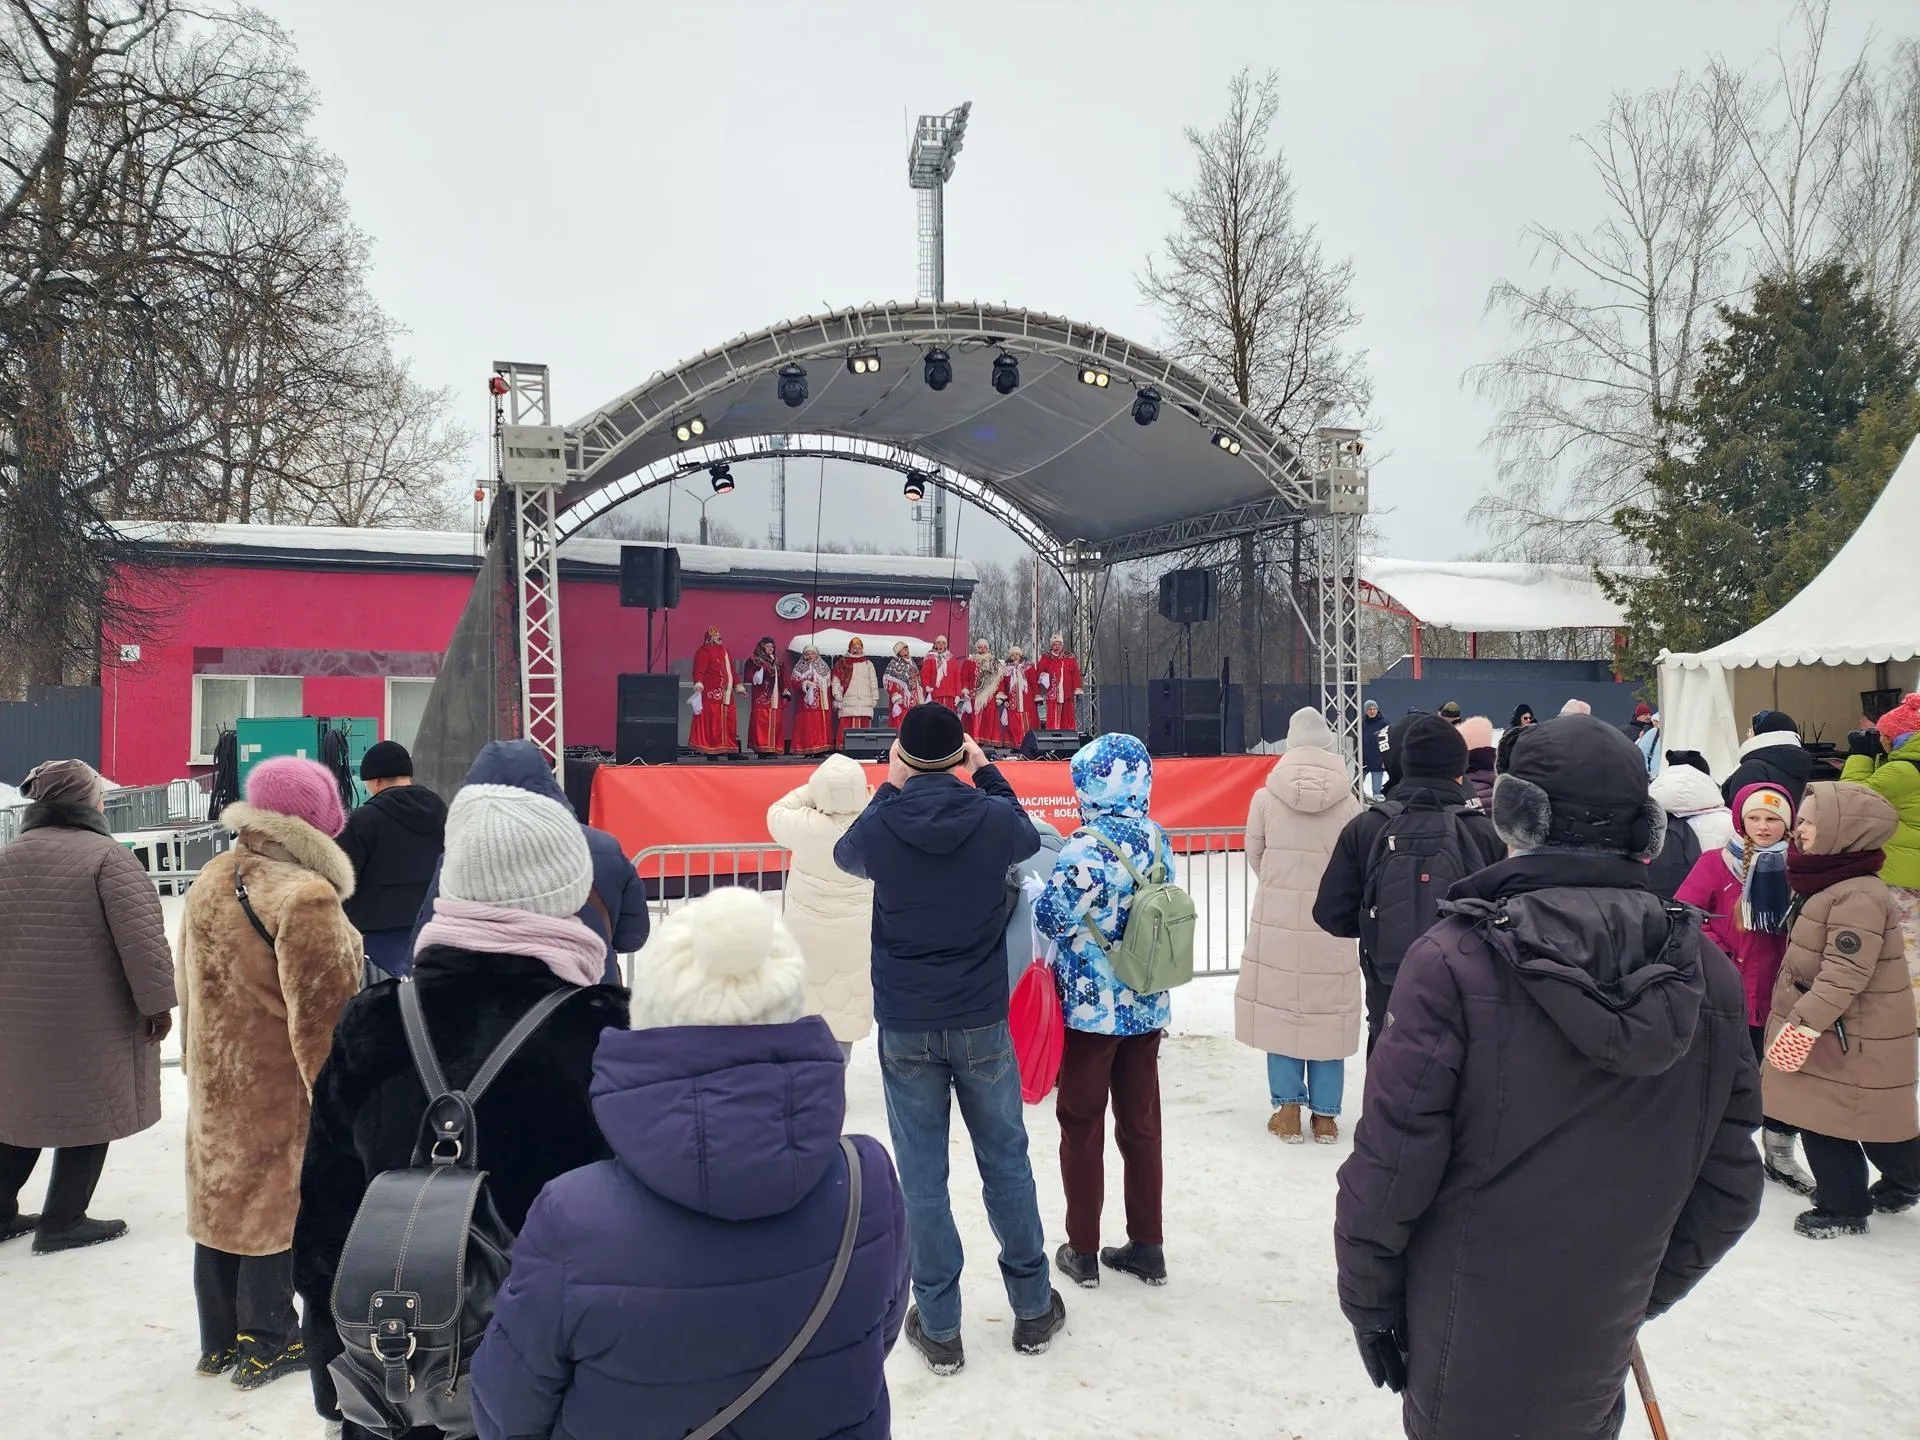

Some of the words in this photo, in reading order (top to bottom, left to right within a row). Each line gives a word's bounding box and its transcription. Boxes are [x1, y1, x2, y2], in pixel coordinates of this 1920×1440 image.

[817, 595, 881, 605] спортивный
[883, 597, 933, 606] комплекс
[814, 606, 931, 623] МЕТАЛЛУРГ
[1017, 796, 1077, 806] МАСЛЕНИЦА
[1054, 808, 1079, 818] ВОЕД
